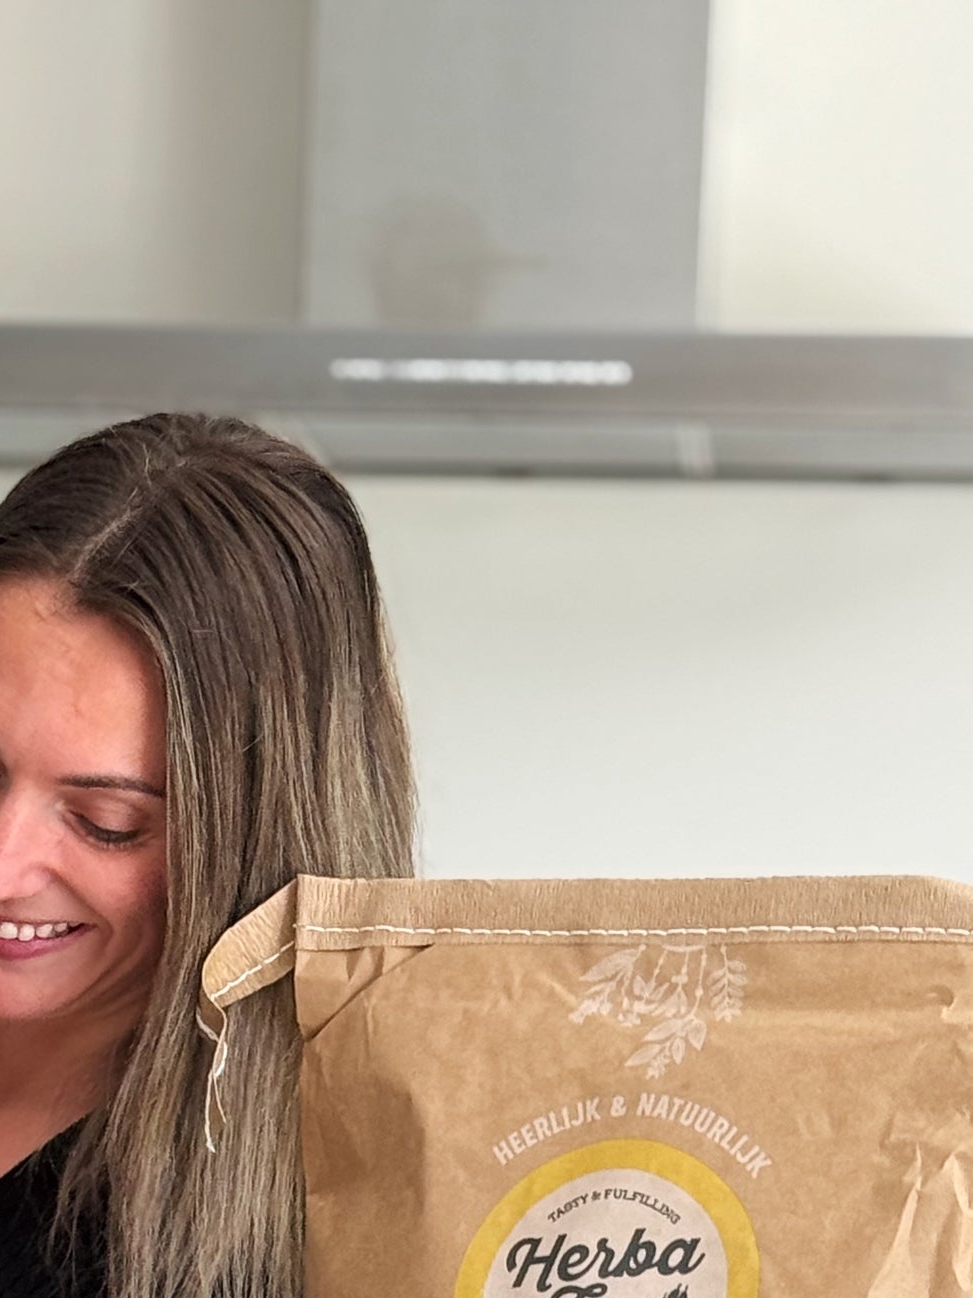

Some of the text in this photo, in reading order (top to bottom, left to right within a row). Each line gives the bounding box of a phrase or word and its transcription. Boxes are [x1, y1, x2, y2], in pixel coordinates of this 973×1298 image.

[492, 1092, 773, 1179] HEERLIJK & NATUURLIJK
[547, 1193, 589, 1223] TASTY
[604, 1188, 681, 1225] FULFILLING
[505, 1228, 706, 1293] Herba
